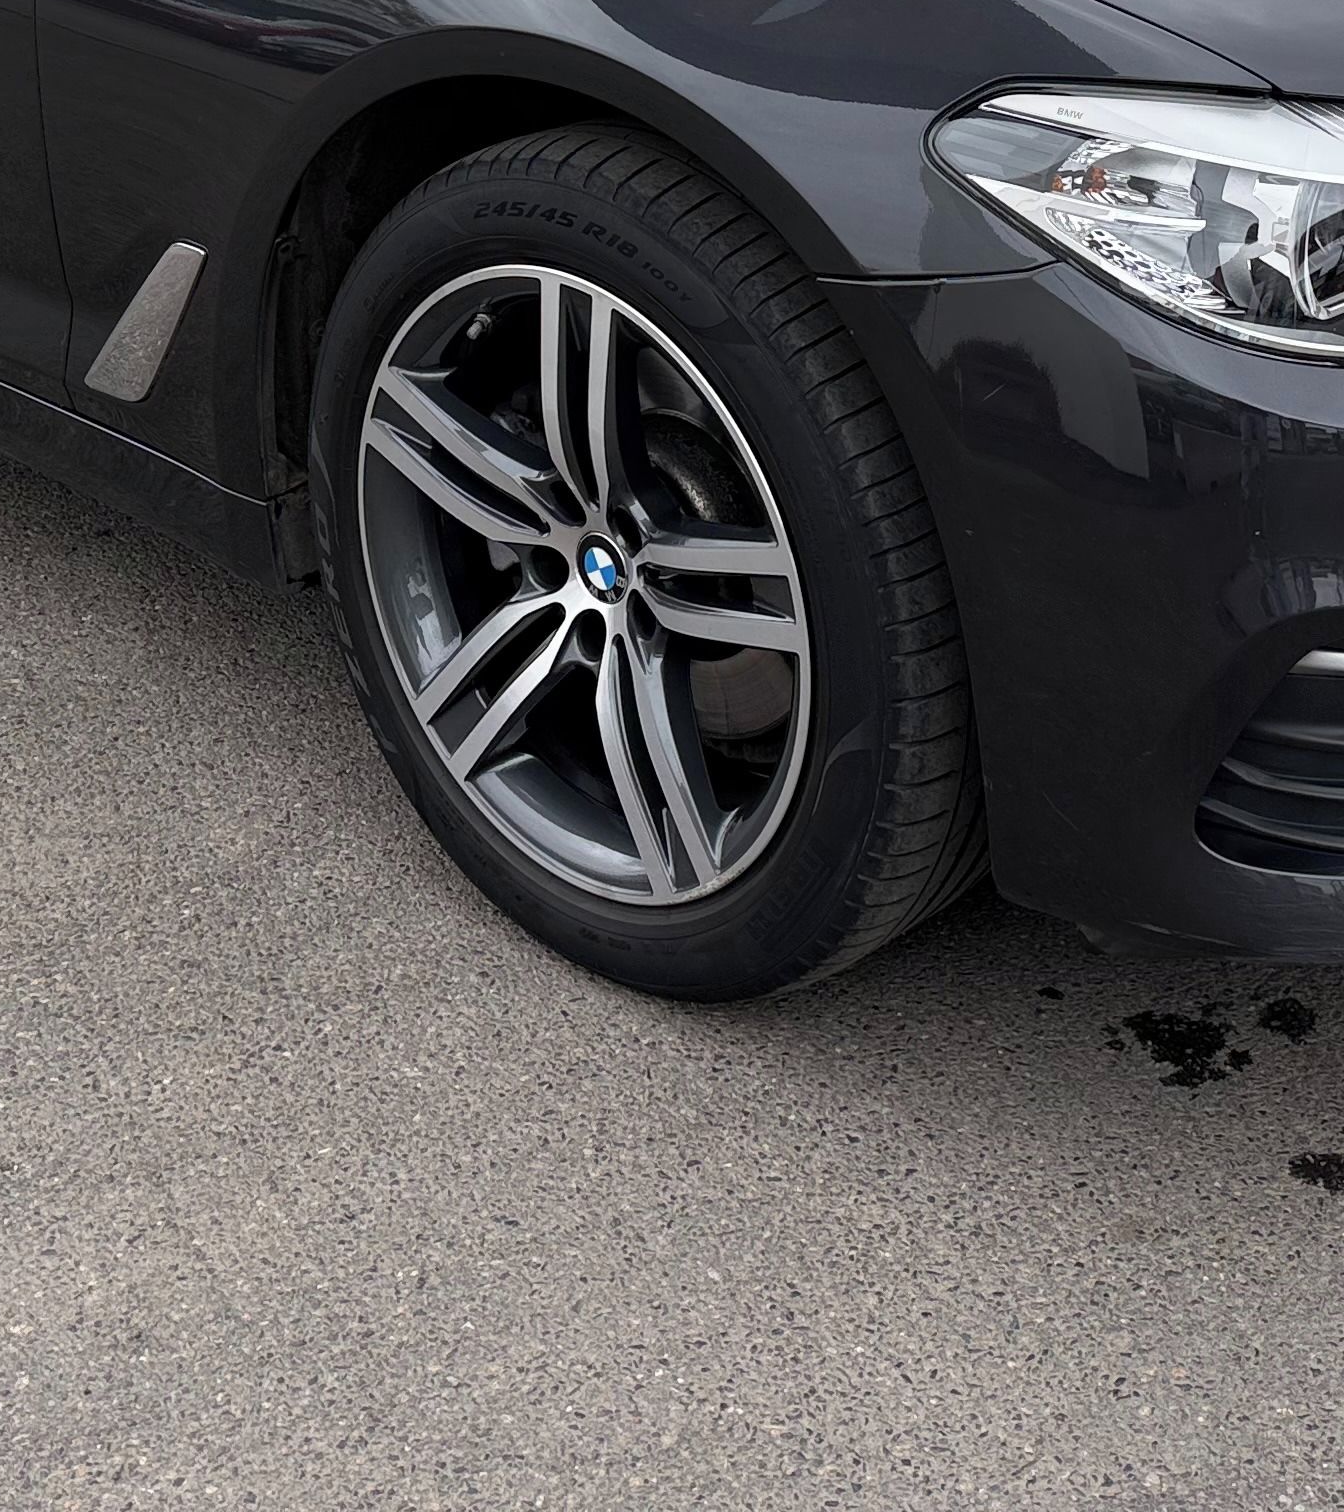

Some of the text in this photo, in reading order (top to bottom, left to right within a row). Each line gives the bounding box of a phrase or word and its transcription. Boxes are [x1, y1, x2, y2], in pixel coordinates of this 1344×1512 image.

[1057, 107, 1083, 119] BMW
[473, 201, 578, 228] 245/45
[582, 221, 639, 258] R18
